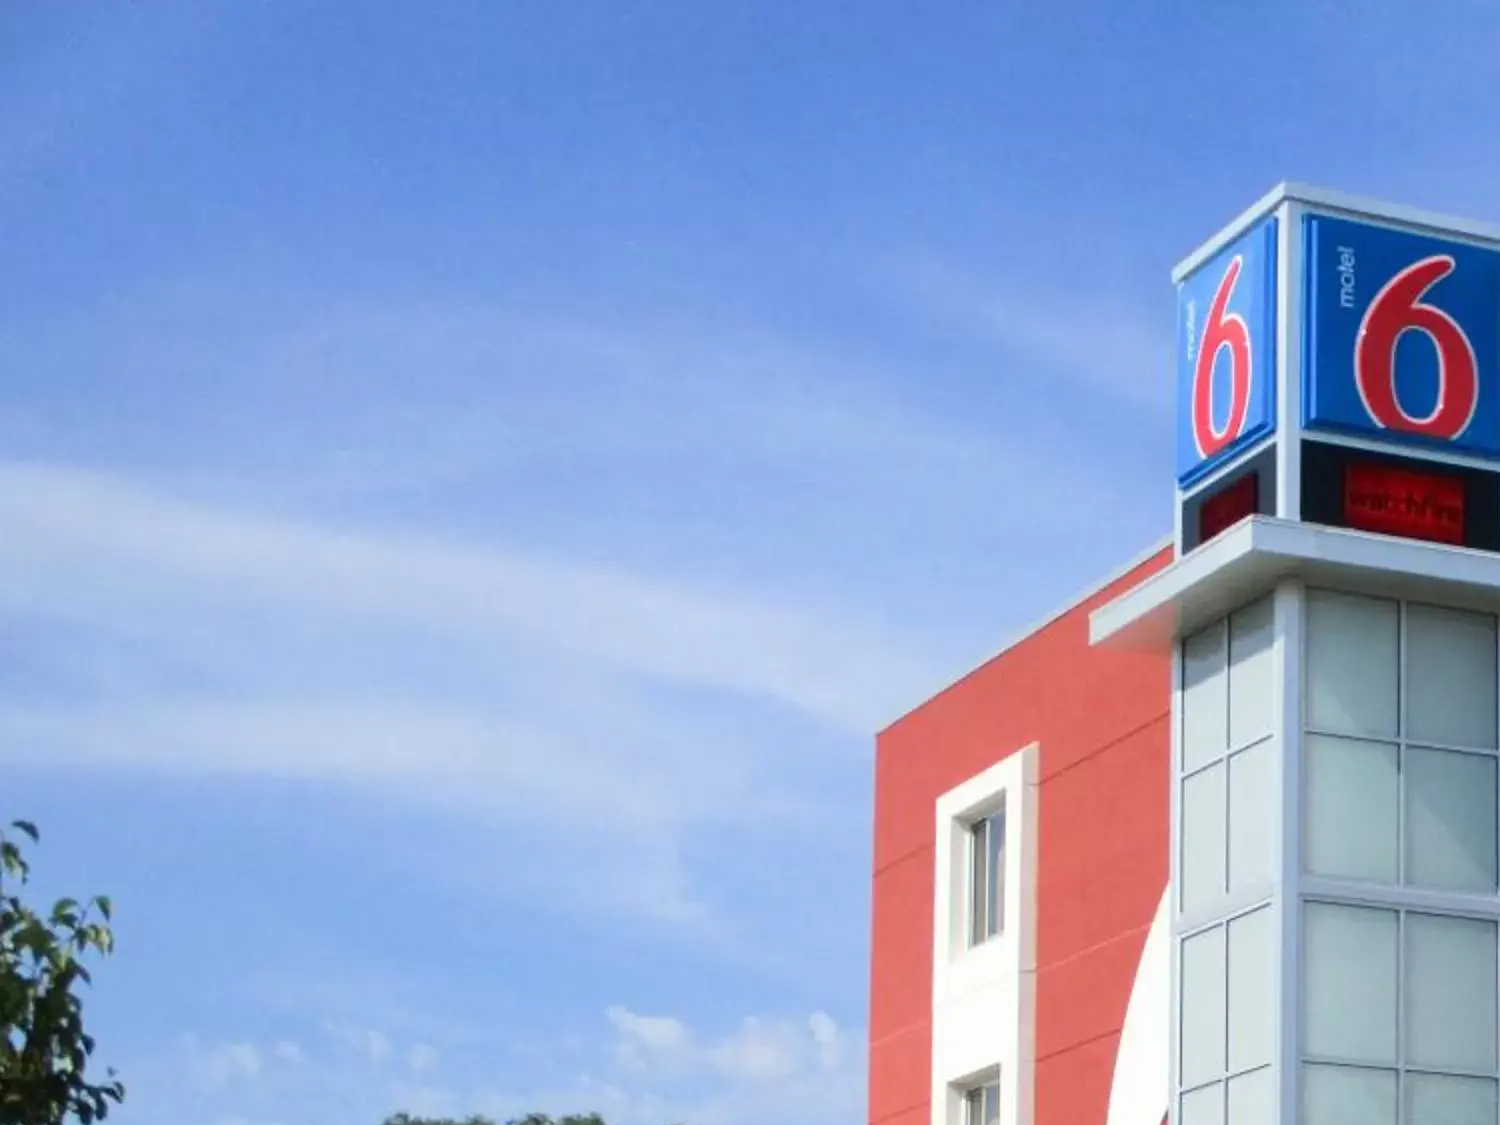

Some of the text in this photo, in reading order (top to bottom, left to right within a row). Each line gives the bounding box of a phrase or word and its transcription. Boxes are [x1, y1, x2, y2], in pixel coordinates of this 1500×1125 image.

[1193, 255, 1252, 459] 6
[1338, 246, 1354, 308] motel
[1354, 255, 1479, 440] 6
